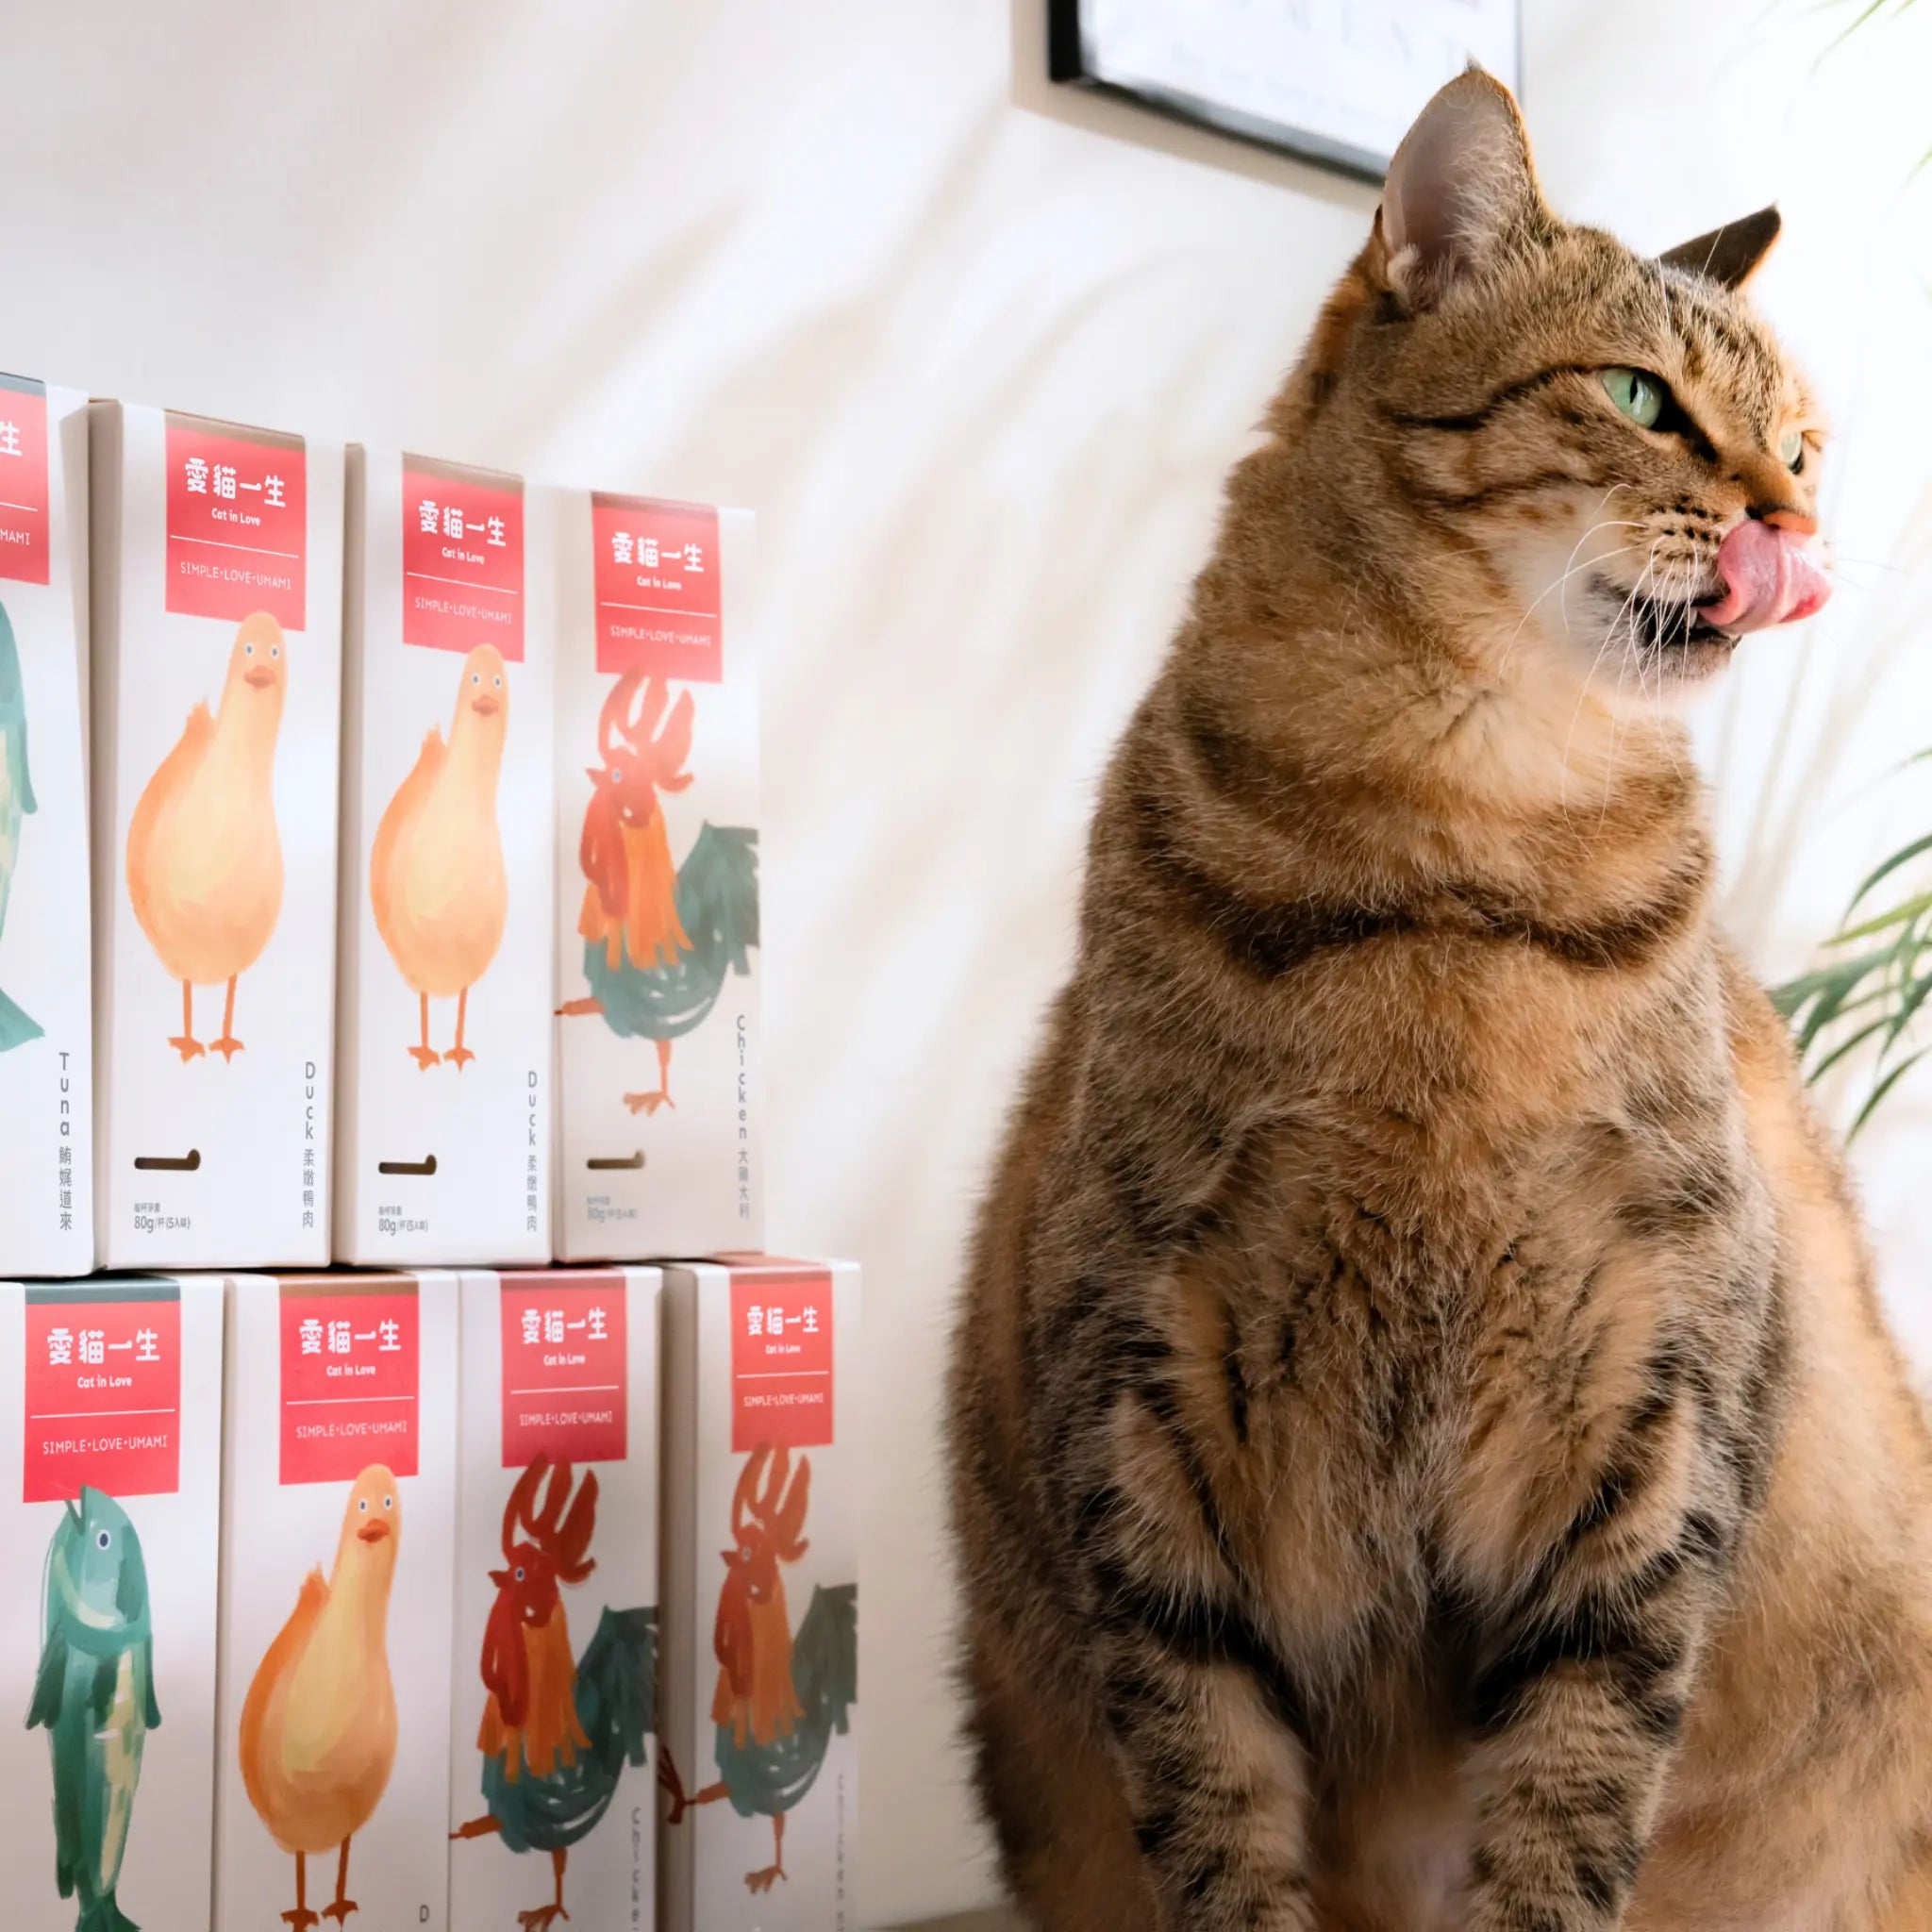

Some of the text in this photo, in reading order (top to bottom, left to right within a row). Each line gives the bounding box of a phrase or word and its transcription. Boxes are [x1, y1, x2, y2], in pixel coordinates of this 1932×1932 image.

[184, 457, 287, 508] 愛貓一生
[211, 508, 261, 526] Cat in Love
[418, 499, 507, 547] 愛貓一生
[441, 546, 485, 565] Cat in Love
[611, 531, 705, 573] 愛貓一生
[637, 575, 682, 591] Cat in Love
[58, 1051, 70, 1137] Tuna
[736, 1014, 747, 1140] Chicken
[305, 1060, 316, 1141] Duck
[527, 1070, 538, 1146] Duck
[298, 1318, 402, 1355] 愛貓一生
[521, 1306, 608, 1344] 愛貓一生
[746, 1305, 819, 1336] 愛貓一生
[46, 1327, 160, 1366] 愛貓一生
[542, 1352, 586, 1366] Cat in Love
[76, 1374, 133, 1389] Cat in Love
[325, 1364, 376, 1377] Cat in Love
